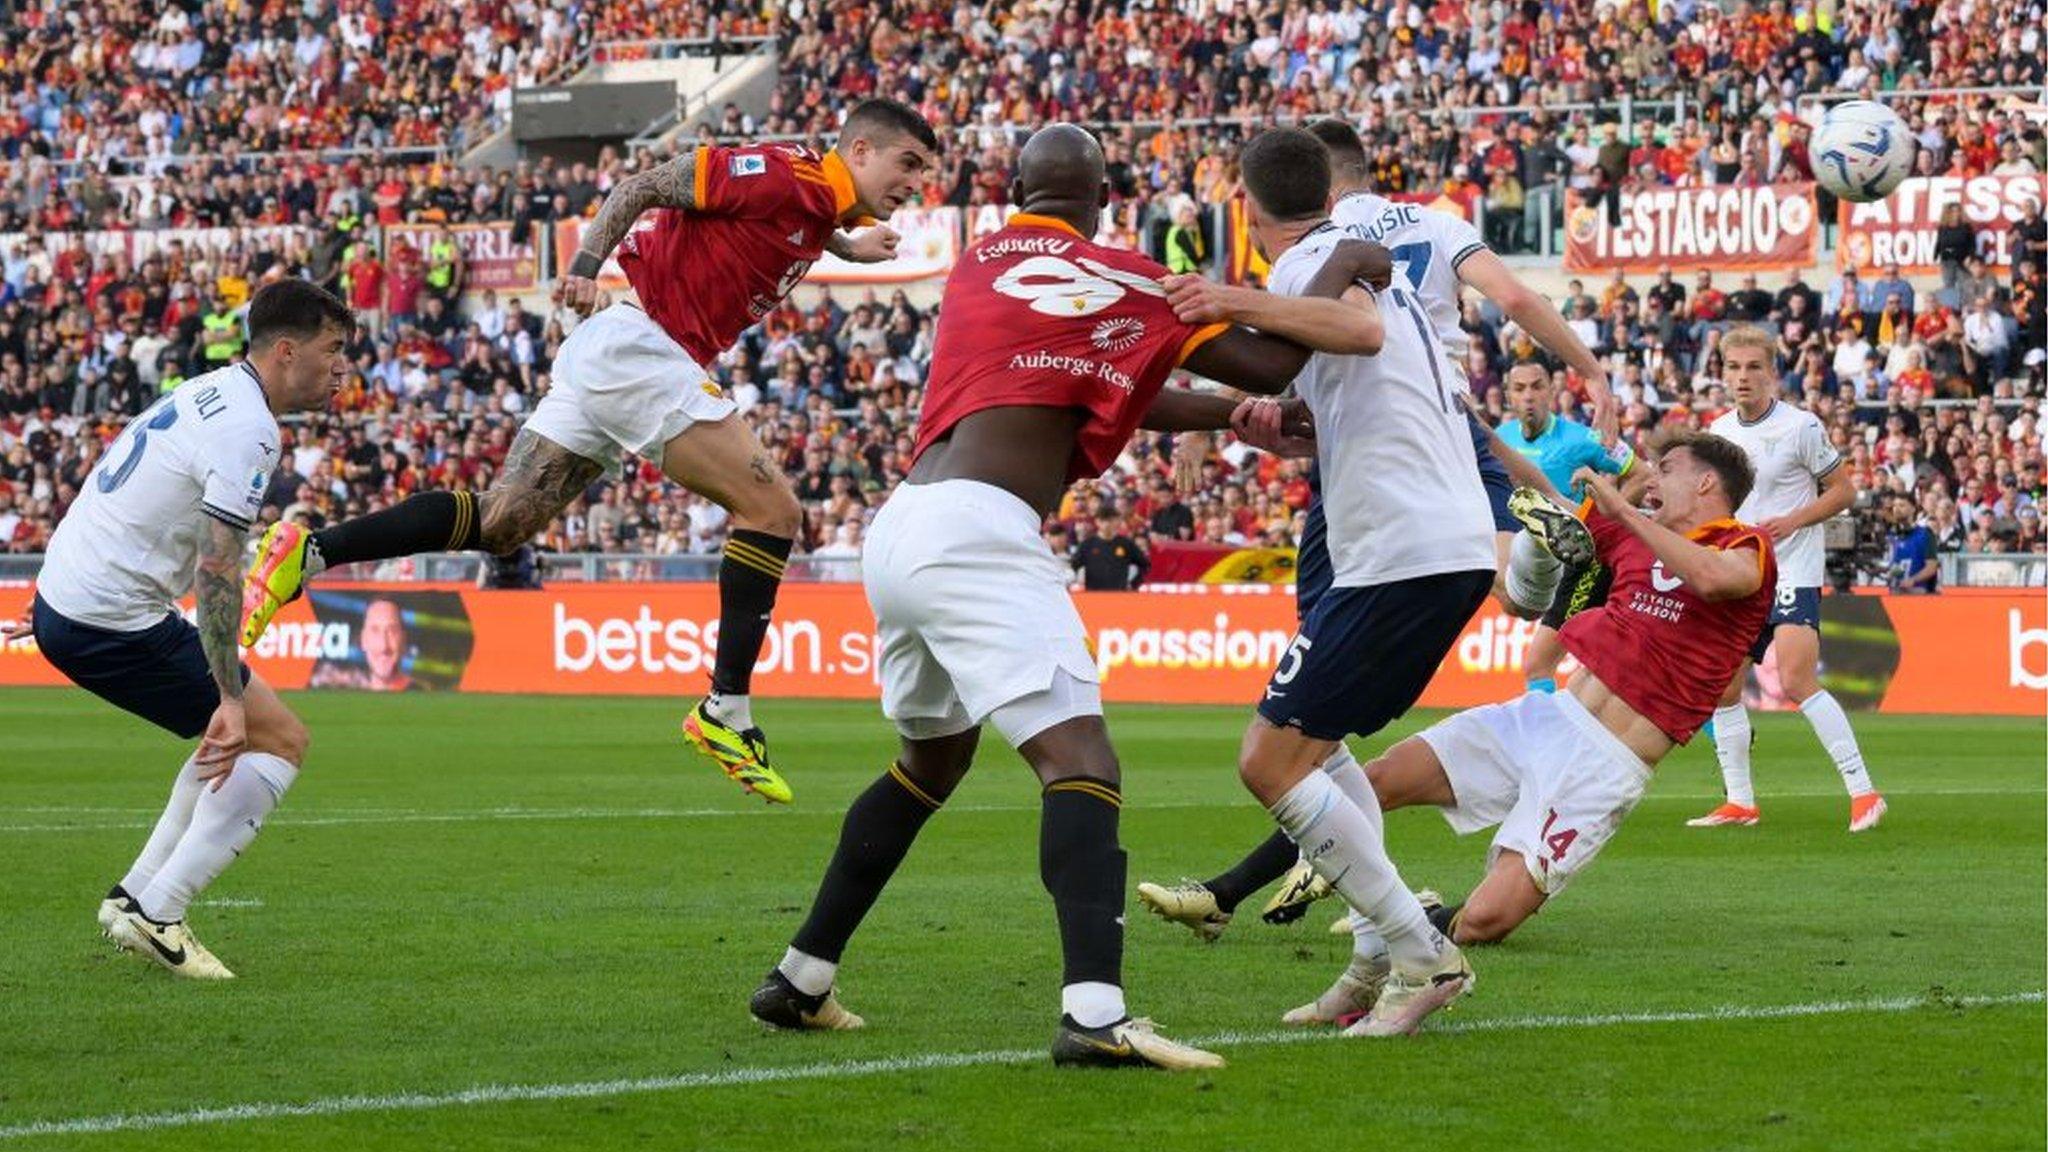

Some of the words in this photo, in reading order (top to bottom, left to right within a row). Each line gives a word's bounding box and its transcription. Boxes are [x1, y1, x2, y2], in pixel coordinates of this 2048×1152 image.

[1009, 350, 1095, 376] Auberge
[1629, 601, 1681, 623] SEASON
[239, 622, 350, 660] enza
[1097, 612, 1290, 683] passion
[1541, 806, 1579, 862] 14
